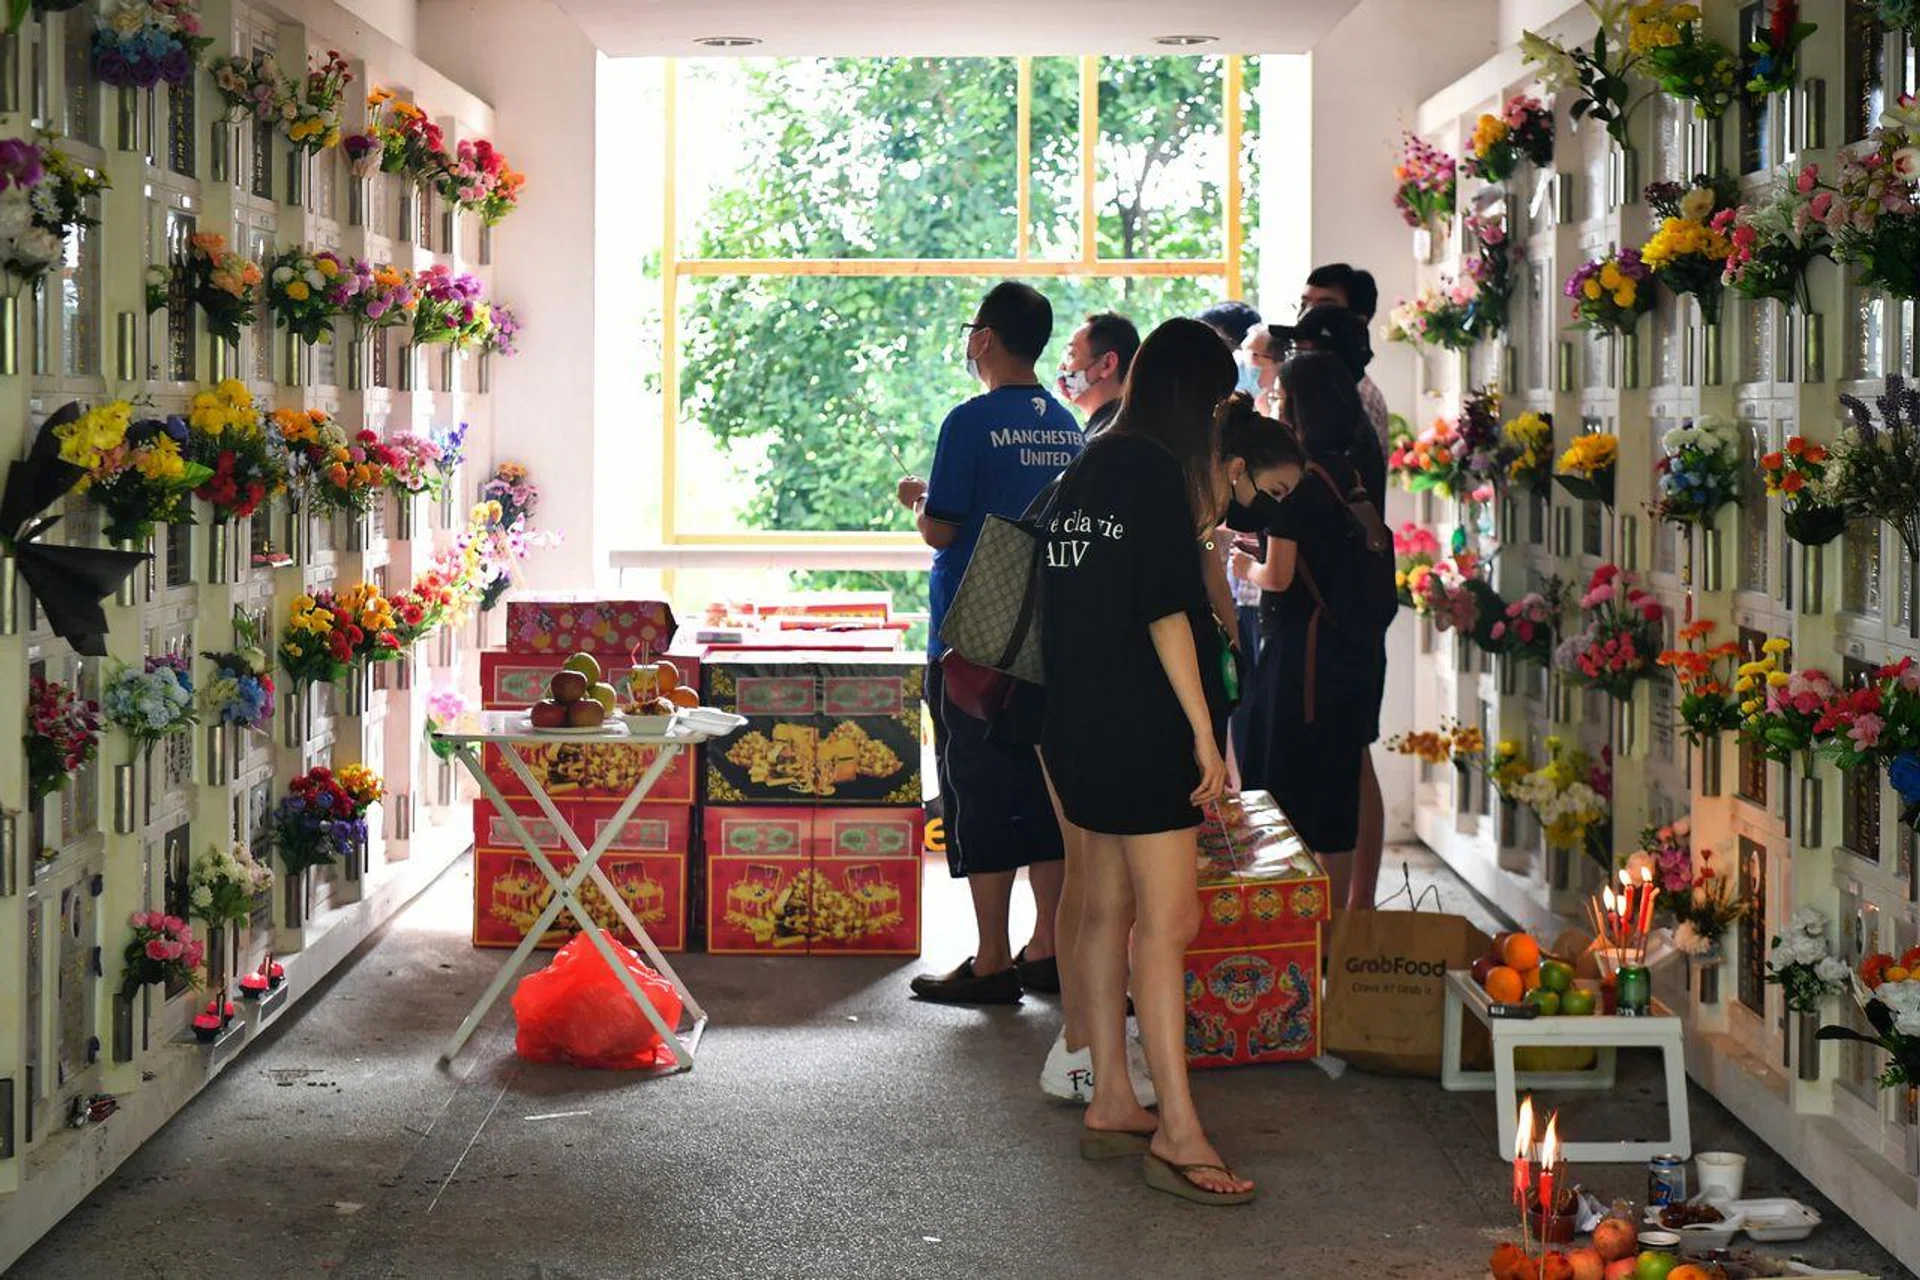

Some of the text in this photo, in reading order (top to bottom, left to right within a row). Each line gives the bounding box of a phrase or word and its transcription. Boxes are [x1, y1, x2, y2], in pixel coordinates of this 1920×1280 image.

[989, 427, 1083, 449] MANCHESTE
[1019, 447, 1071, 467] UNITED
[1345, 955, 1447, 978] GrabFood
